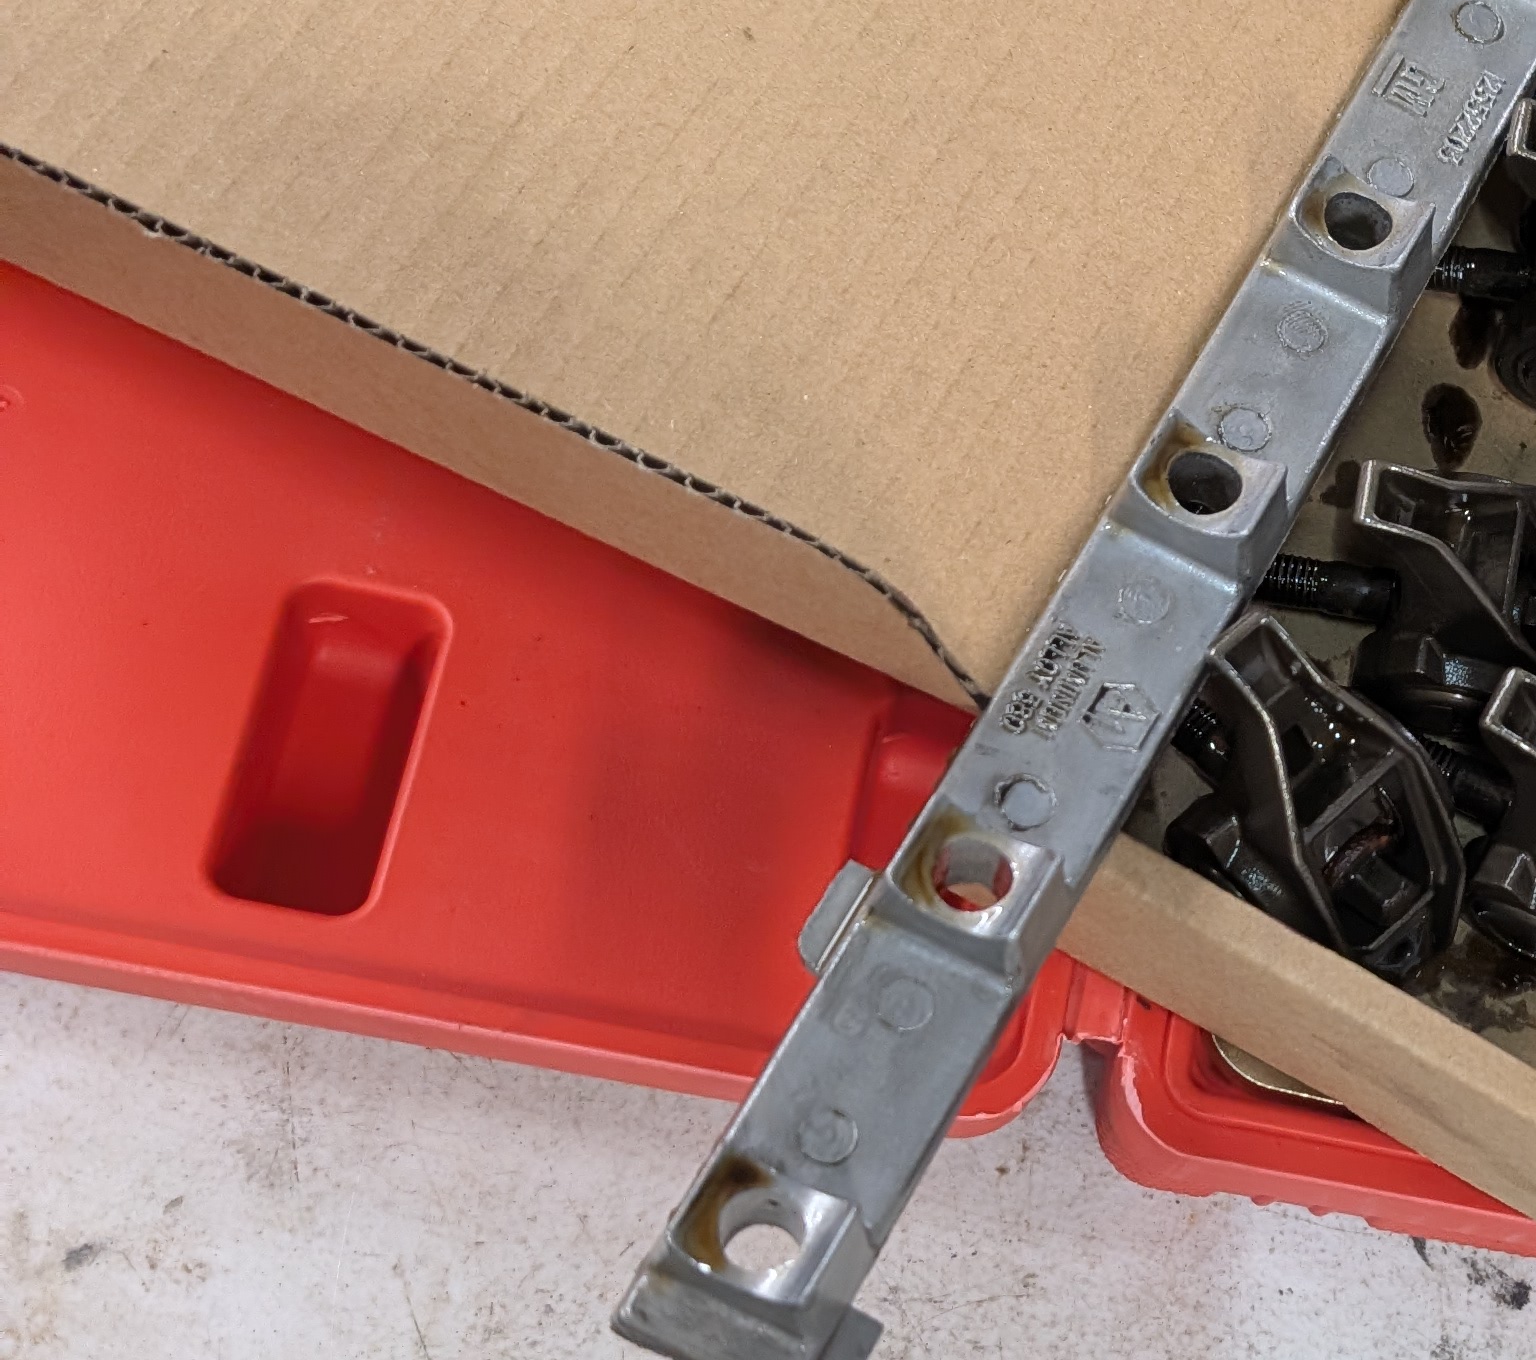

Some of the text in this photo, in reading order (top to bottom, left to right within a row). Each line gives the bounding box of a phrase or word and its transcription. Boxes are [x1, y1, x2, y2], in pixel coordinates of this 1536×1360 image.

[1434, 69, 1508, 170] 12552203
[996, 619, 1082, 738] ALLOY 380
[1030, 635, 1108, 744] ALUMINUM
